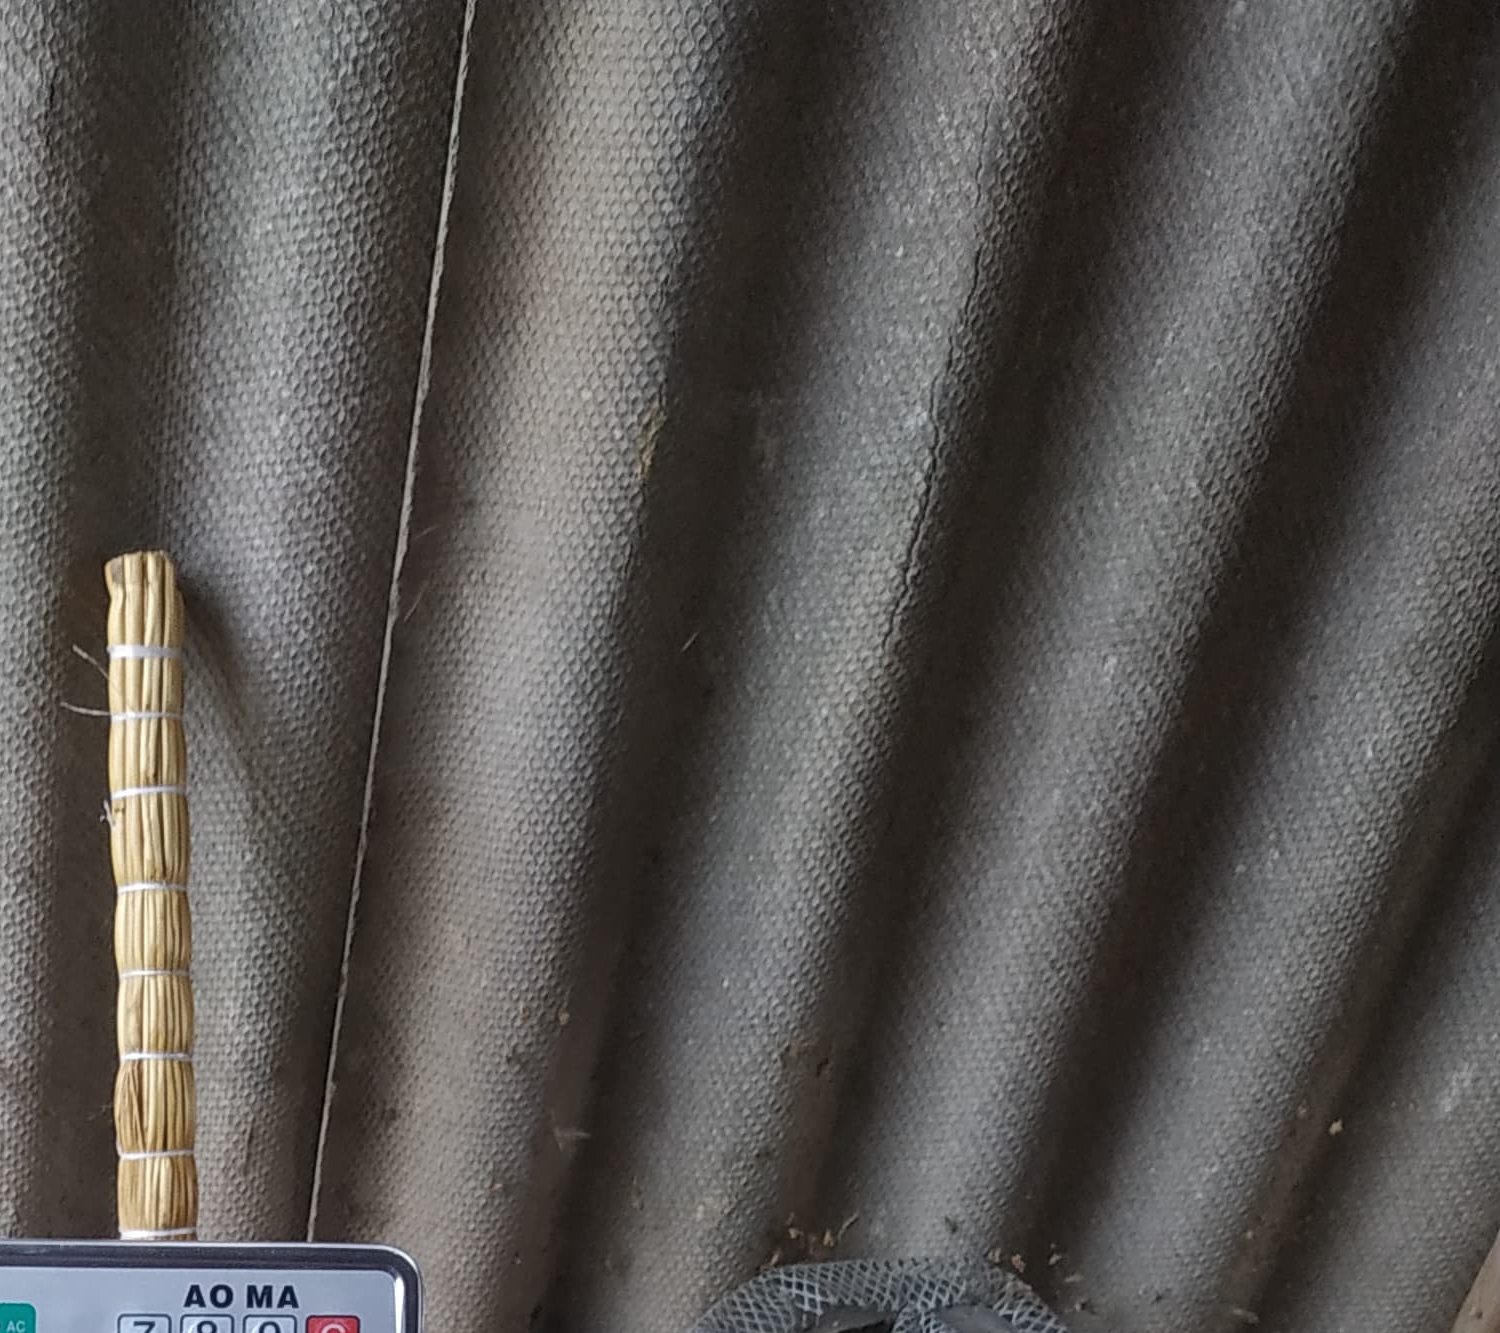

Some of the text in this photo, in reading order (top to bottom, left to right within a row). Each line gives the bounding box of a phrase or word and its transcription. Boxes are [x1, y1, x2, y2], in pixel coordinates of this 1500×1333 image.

[183, 1285, 299, 1309] AO MA
[6, 1321, 26, 1333] AC
